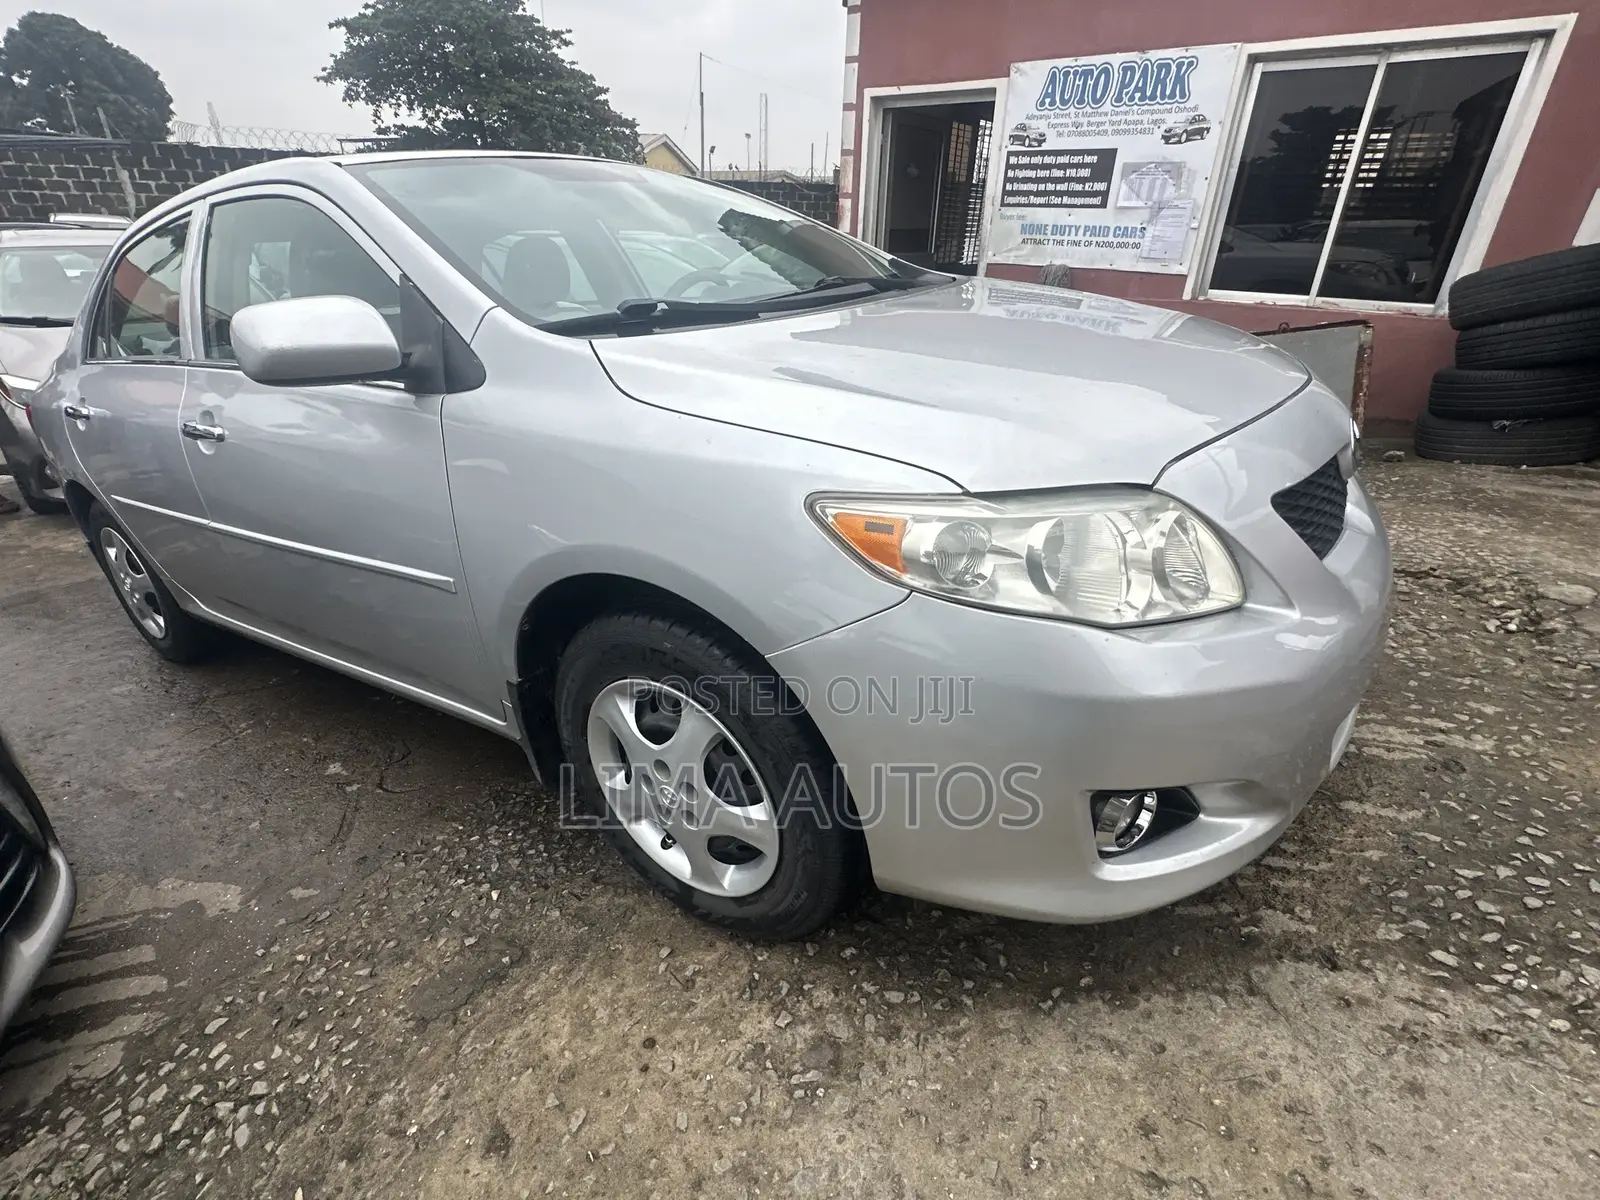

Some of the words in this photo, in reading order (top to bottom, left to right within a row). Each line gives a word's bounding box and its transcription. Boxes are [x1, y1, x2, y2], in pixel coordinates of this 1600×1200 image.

[1036, 62, 1114, 111] AUTO
[1111, 56, 1198, 107] PARK
[1053, 111, 1072, 120] Street,
[1081, 110, 1109, 118] Matthew
[1110, 108, 1135, 116] Daniel's
[1136, 106, 1172, 116] Compound
[1174, 104, 1199, 113] Oshodi
[1047, 121, 1069, 130] Express
[1086, 120, 1107, 128] Berger
[1123, 119, 1145, 127] Apapa,
[1111, 128, 1154, 136] 09099354831
[1009, 155, 1018, 164] We
[1031, 155, 1043, 165] only
[1043, 155, 1056, 165] duty
[1056, 154, 1070, 164] paid
[1070, 155, 1083, 163] cars
[1083, 154, 1098, 163] here
[1007, 169, 1014, 177] No
[1014, 169, 1036, 178] Fighting
[1036, 169, 1050, 177] here
[1046, 182, 1055, 190] the
[1055, 182, 1068, 190] wall
[1020, 223, 1049, 235] NONE
[1050, 224, 1081, 237] DUTY
[1082, 225, 1111, 238] PAID
[1112, 226, 1146, 240] CARS
[1020, 238, 1051, 246] ATTRACT
[1052, 238, 1065, 246] THE
[1066, 239, 1081, 247] FINE
[1083, 240, 1094, 248] OF
